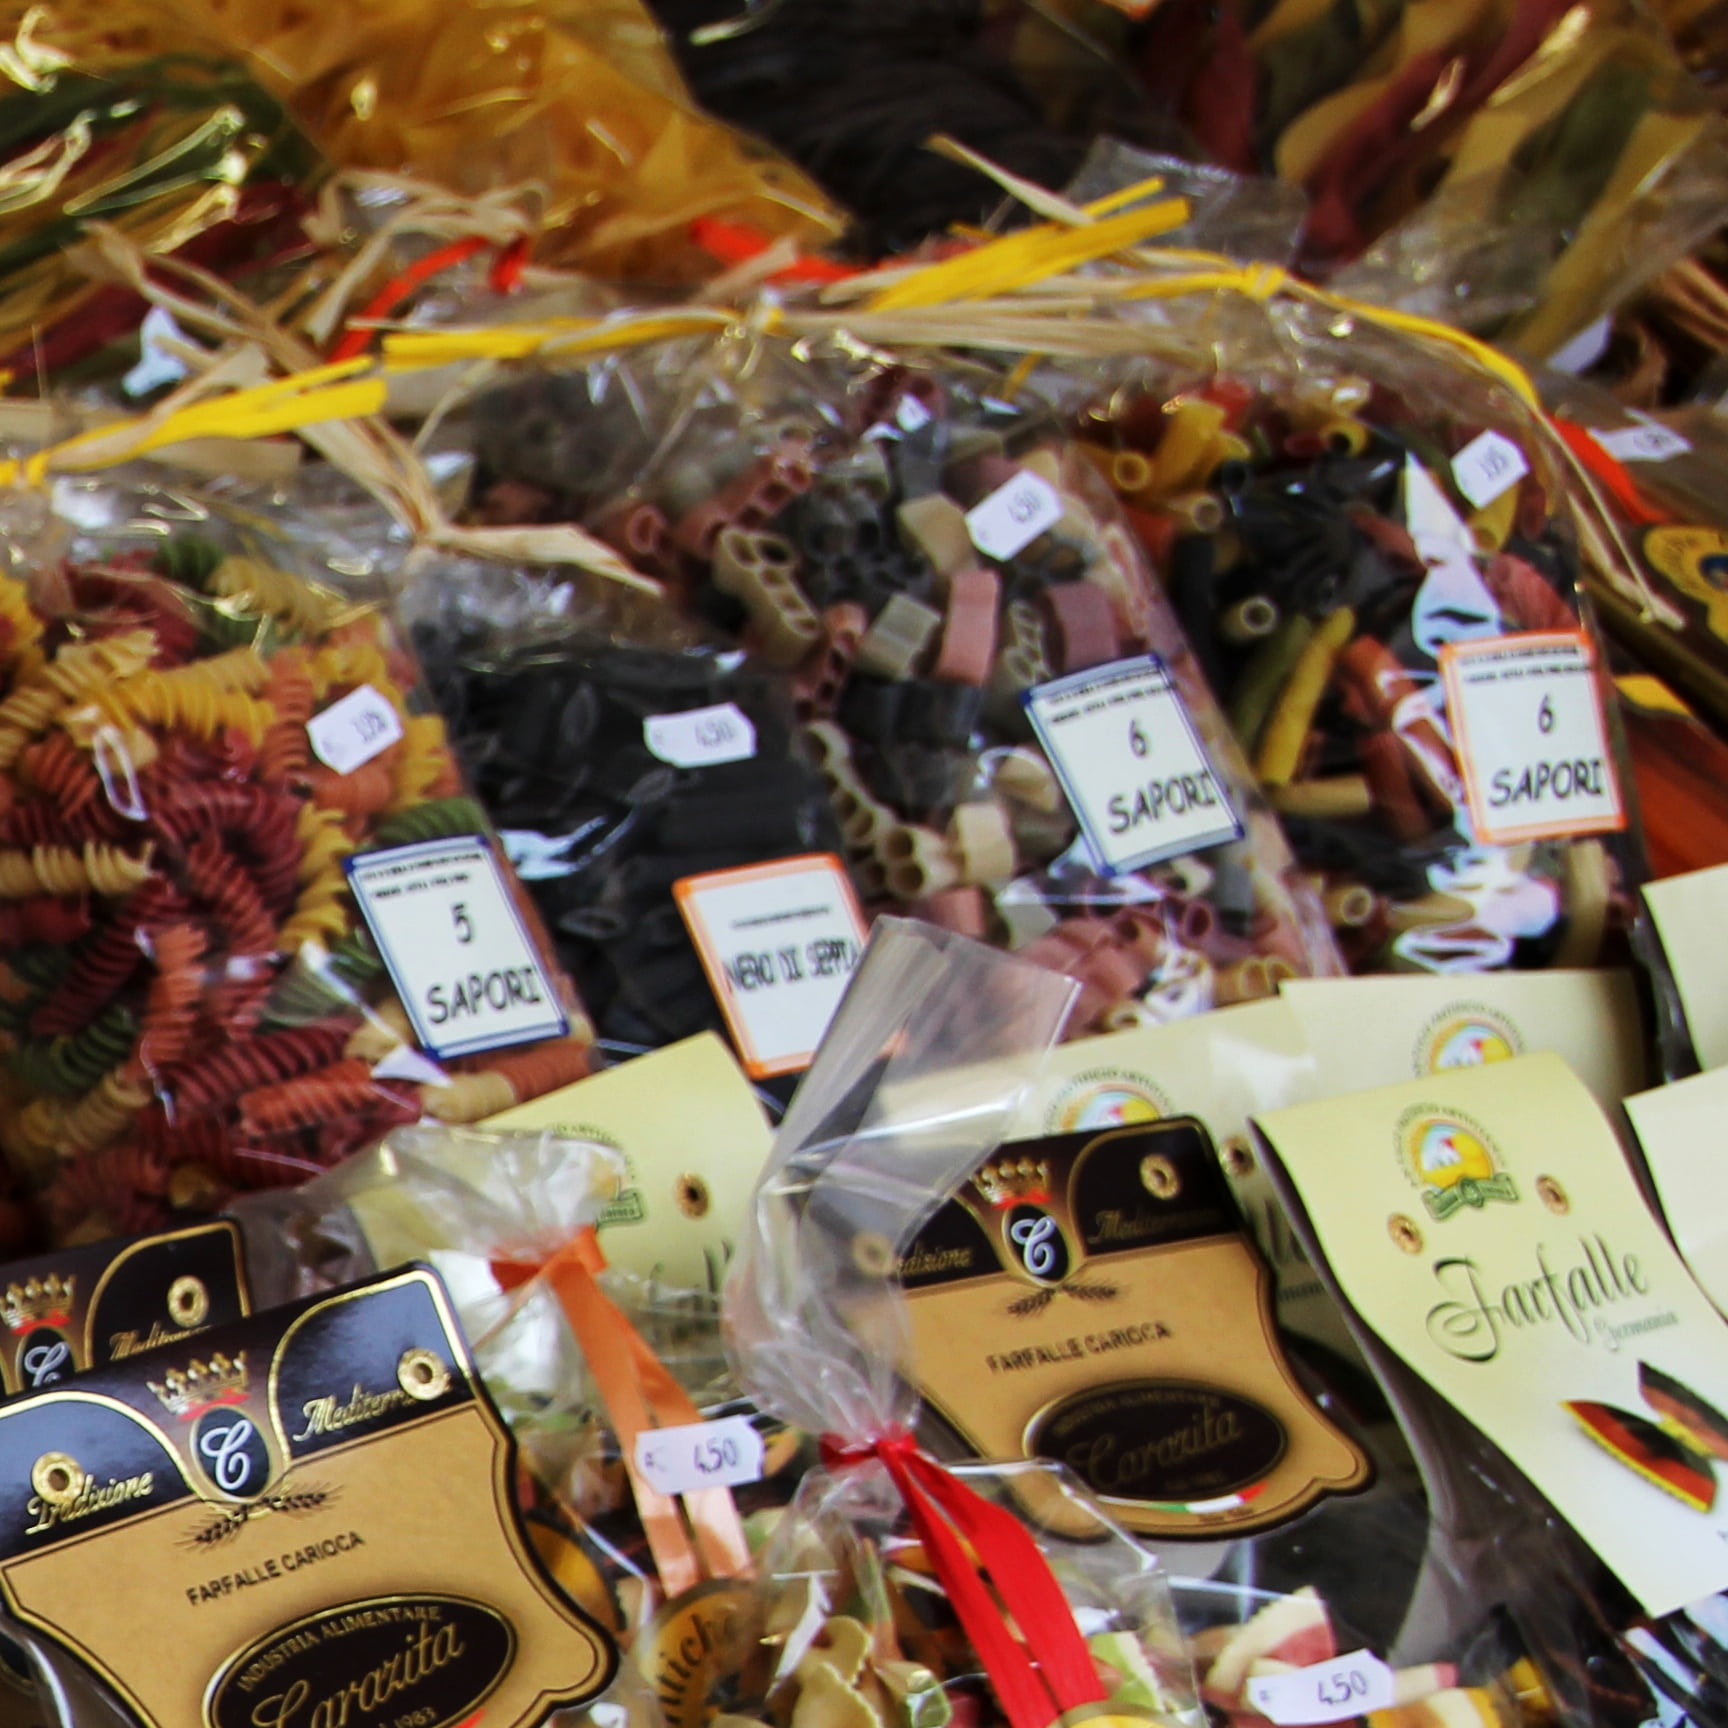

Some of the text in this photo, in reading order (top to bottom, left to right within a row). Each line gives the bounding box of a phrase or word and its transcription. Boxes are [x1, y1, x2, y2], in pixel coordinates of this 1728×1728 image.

[1127, 718, 1149, 758] 6
[1538, 693, 1556, 735] 6
[1106, 769, 1218, 835] SAPORI
[1487, 758, 1604, 808] SAPORI
[450, 902, 474, 945] 5
[425, 965, 542, 1025] SAPORI
[1425, 1226, 1650, 1364] Farfalle
[986, 1318, 1174, 1375] FARFALLE CARIOCA
[185, 1530, 367, 1607] FARFALLE CARIOCA
[236, 1604, 443, 1694] INDUSTRIA ALIMENTARE
